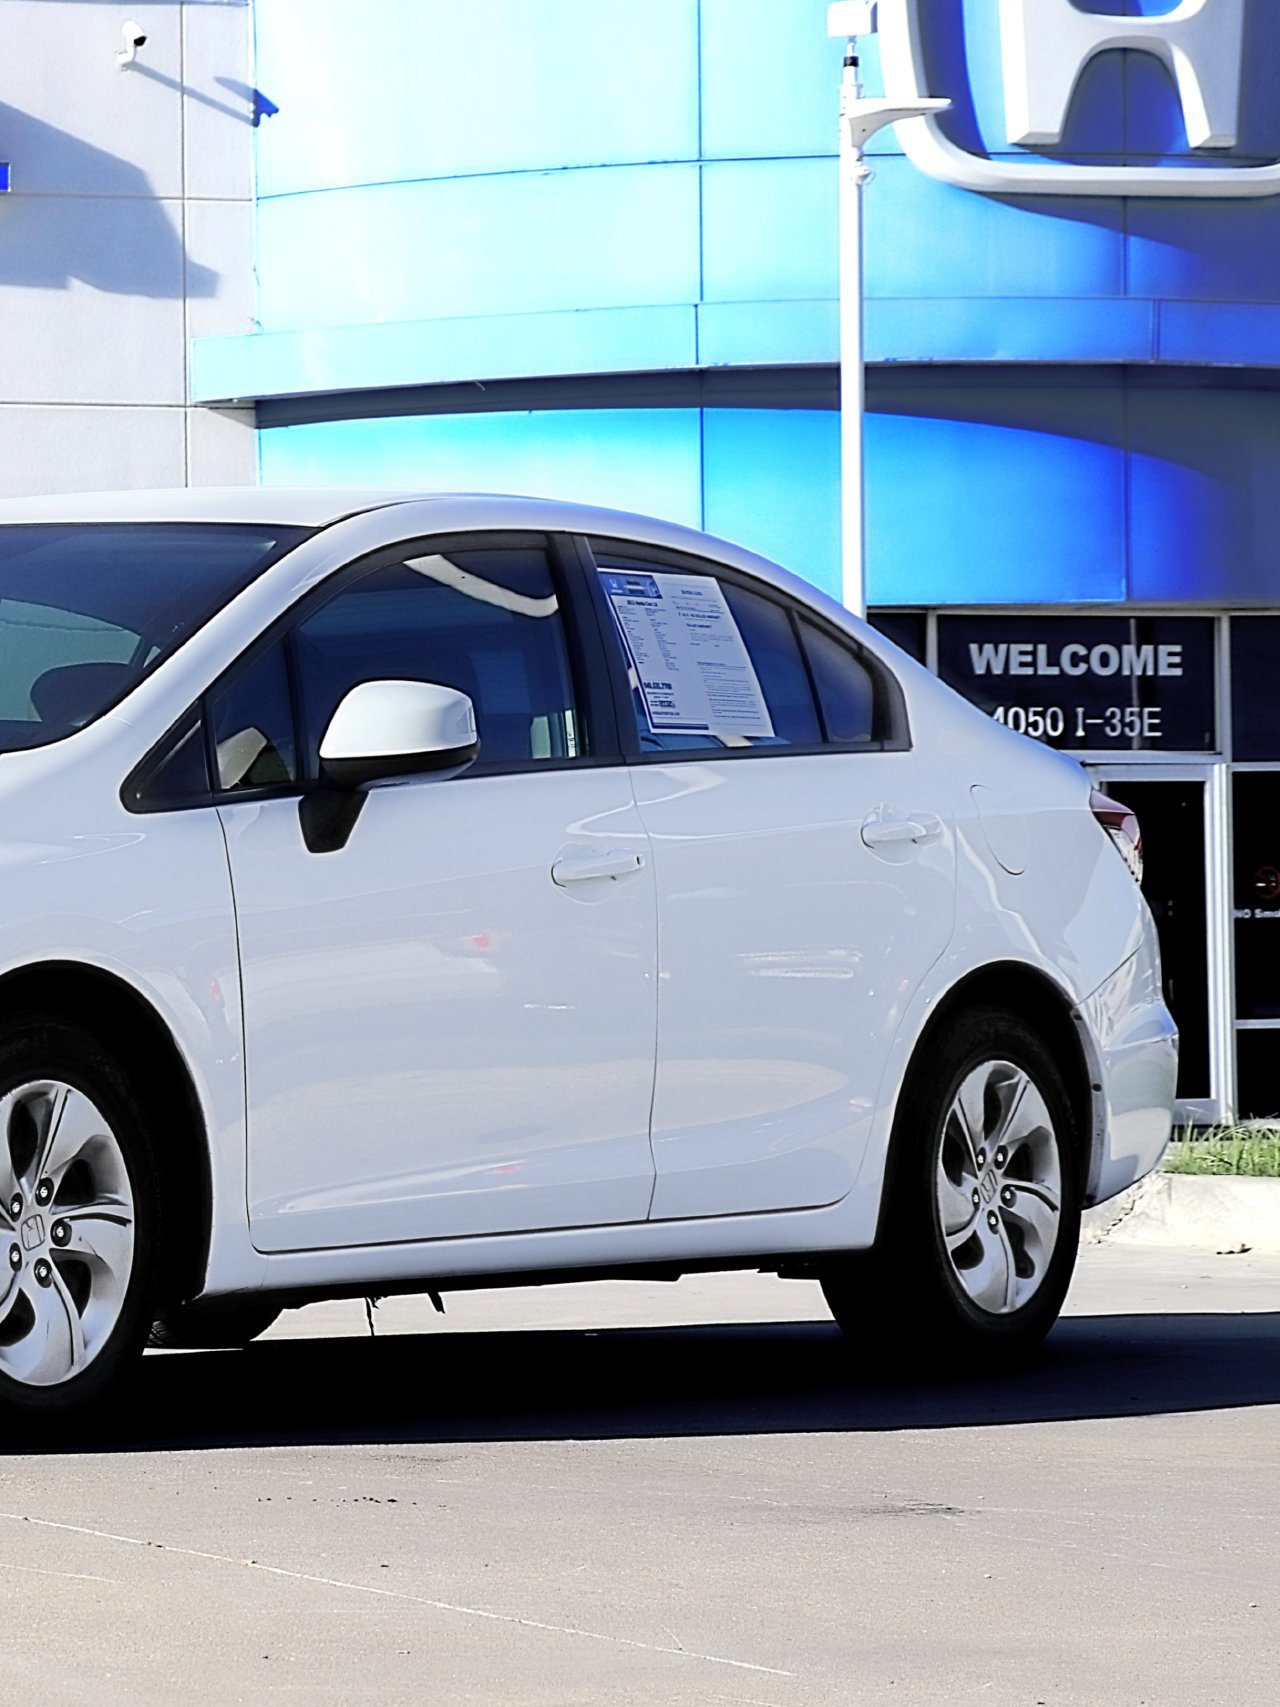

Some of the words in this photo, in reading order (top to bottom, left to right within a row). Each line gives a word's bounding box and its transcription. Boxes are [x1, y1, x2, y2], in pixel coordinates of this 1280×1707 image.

[969, 643, 1183, 676] WELCOME
[991, 706, 1064, 737] 4050
[1075, 707, 1162, 737] I-35E
